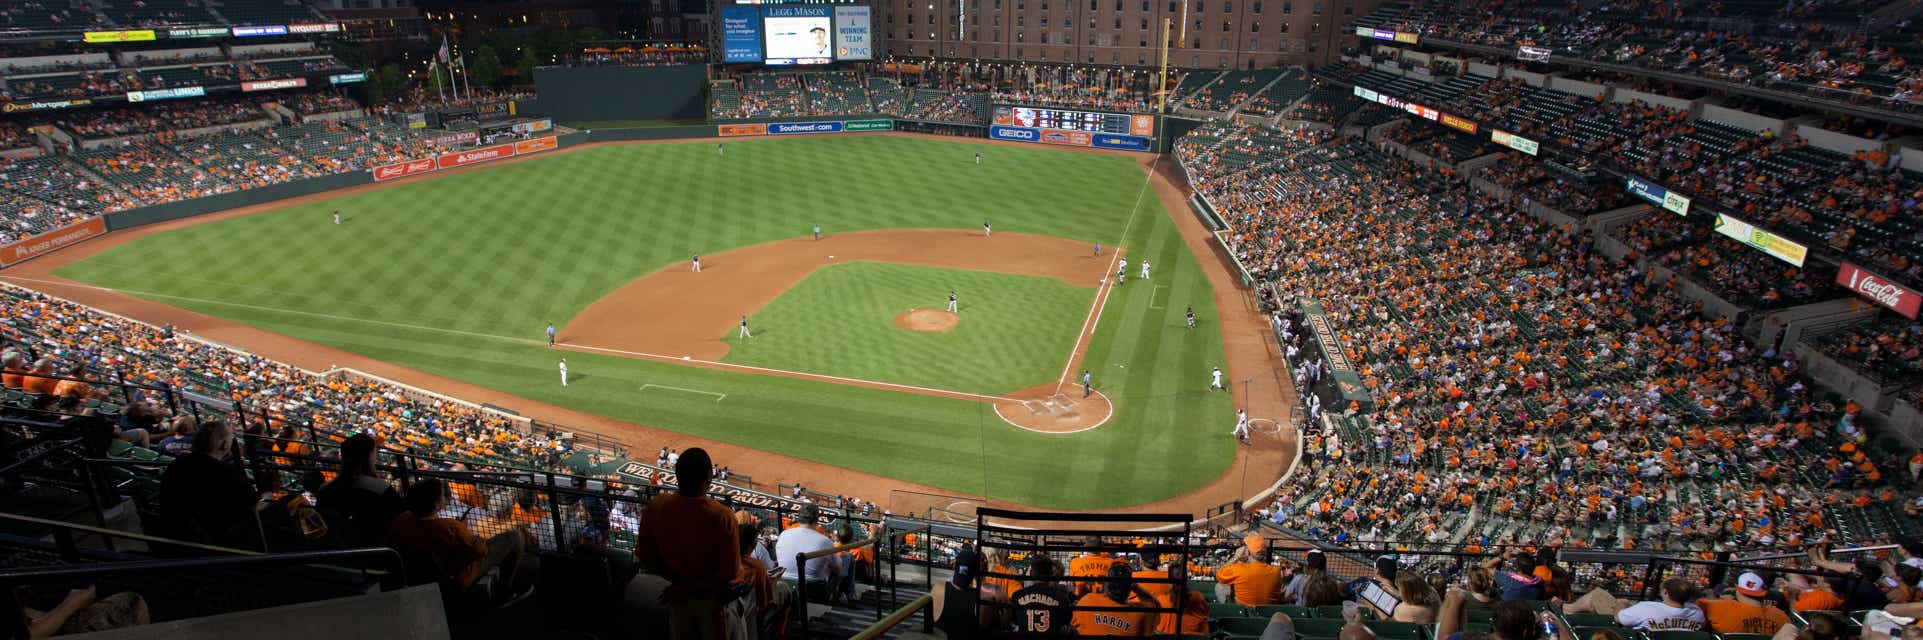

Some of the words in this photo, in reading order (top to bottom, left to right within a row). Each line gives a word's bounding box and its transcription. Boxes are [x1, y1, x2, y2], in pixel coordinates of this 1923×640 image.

[769, 7, 793, 16] LEGG
[794, 7, 825, 16] MASON
[850, 47, 868, 55] PNC
[173, 86, 205, 97] UNION
[998, 128, 1033, 139] GEICO
[1858, 275, 1905, 307] Coca-Cola
[1026, 609, 1050, 633] 13
[1095, 613, 1132, 633] HARDY
